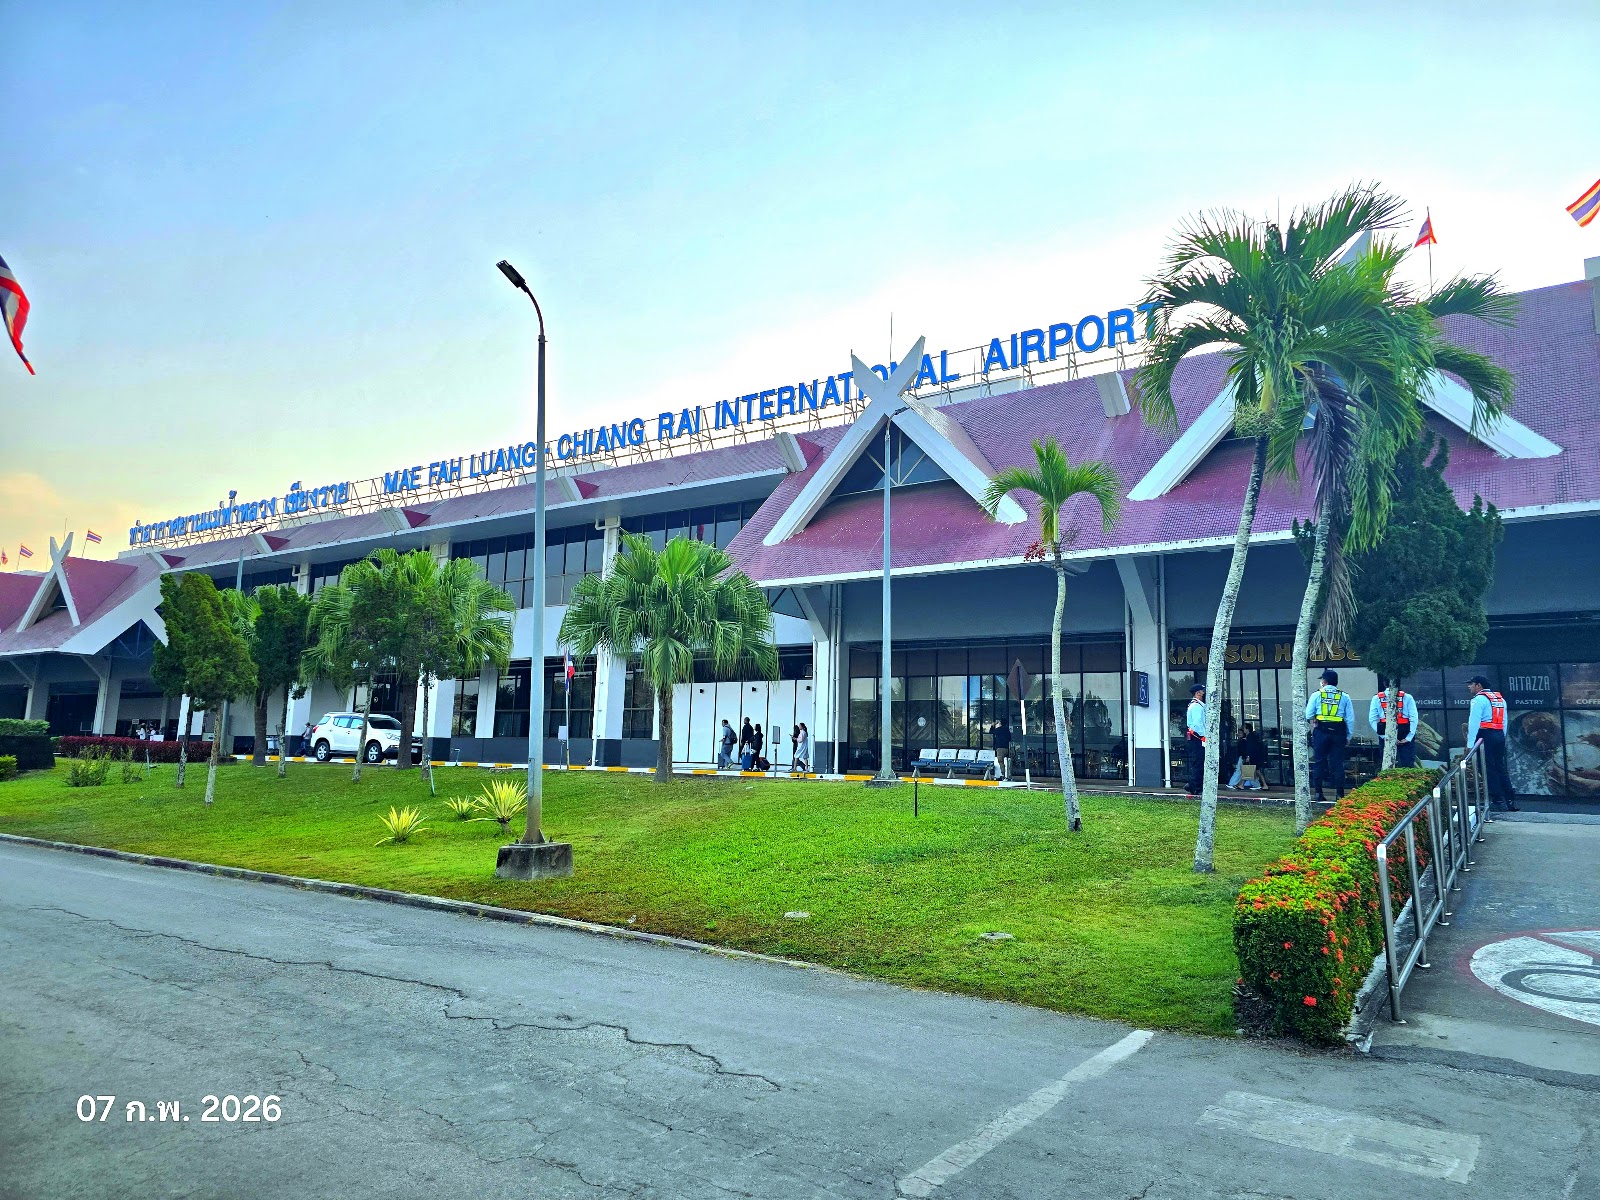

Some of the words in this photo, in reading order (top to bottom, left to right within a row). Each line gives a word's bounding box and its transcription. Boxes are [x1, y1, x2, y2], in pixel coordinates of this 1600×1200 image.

[384, 466, 422, 495] MAE
[428, 456, 462, 485] FAH
[470, 442, 536, 478] LUANG
[557, 418, 645, 461] CHIANG
[658, 405, 702, 441] RAI
[714, 349, 960, 431] INTERNATAL
[983, 300, 1164, 376] AIRPORT
[284, 481, 350, 515] เชียงราย
[1275, 642, 1361, 662] HUS
[1508, 676, 1550, 691] RITAZZA
